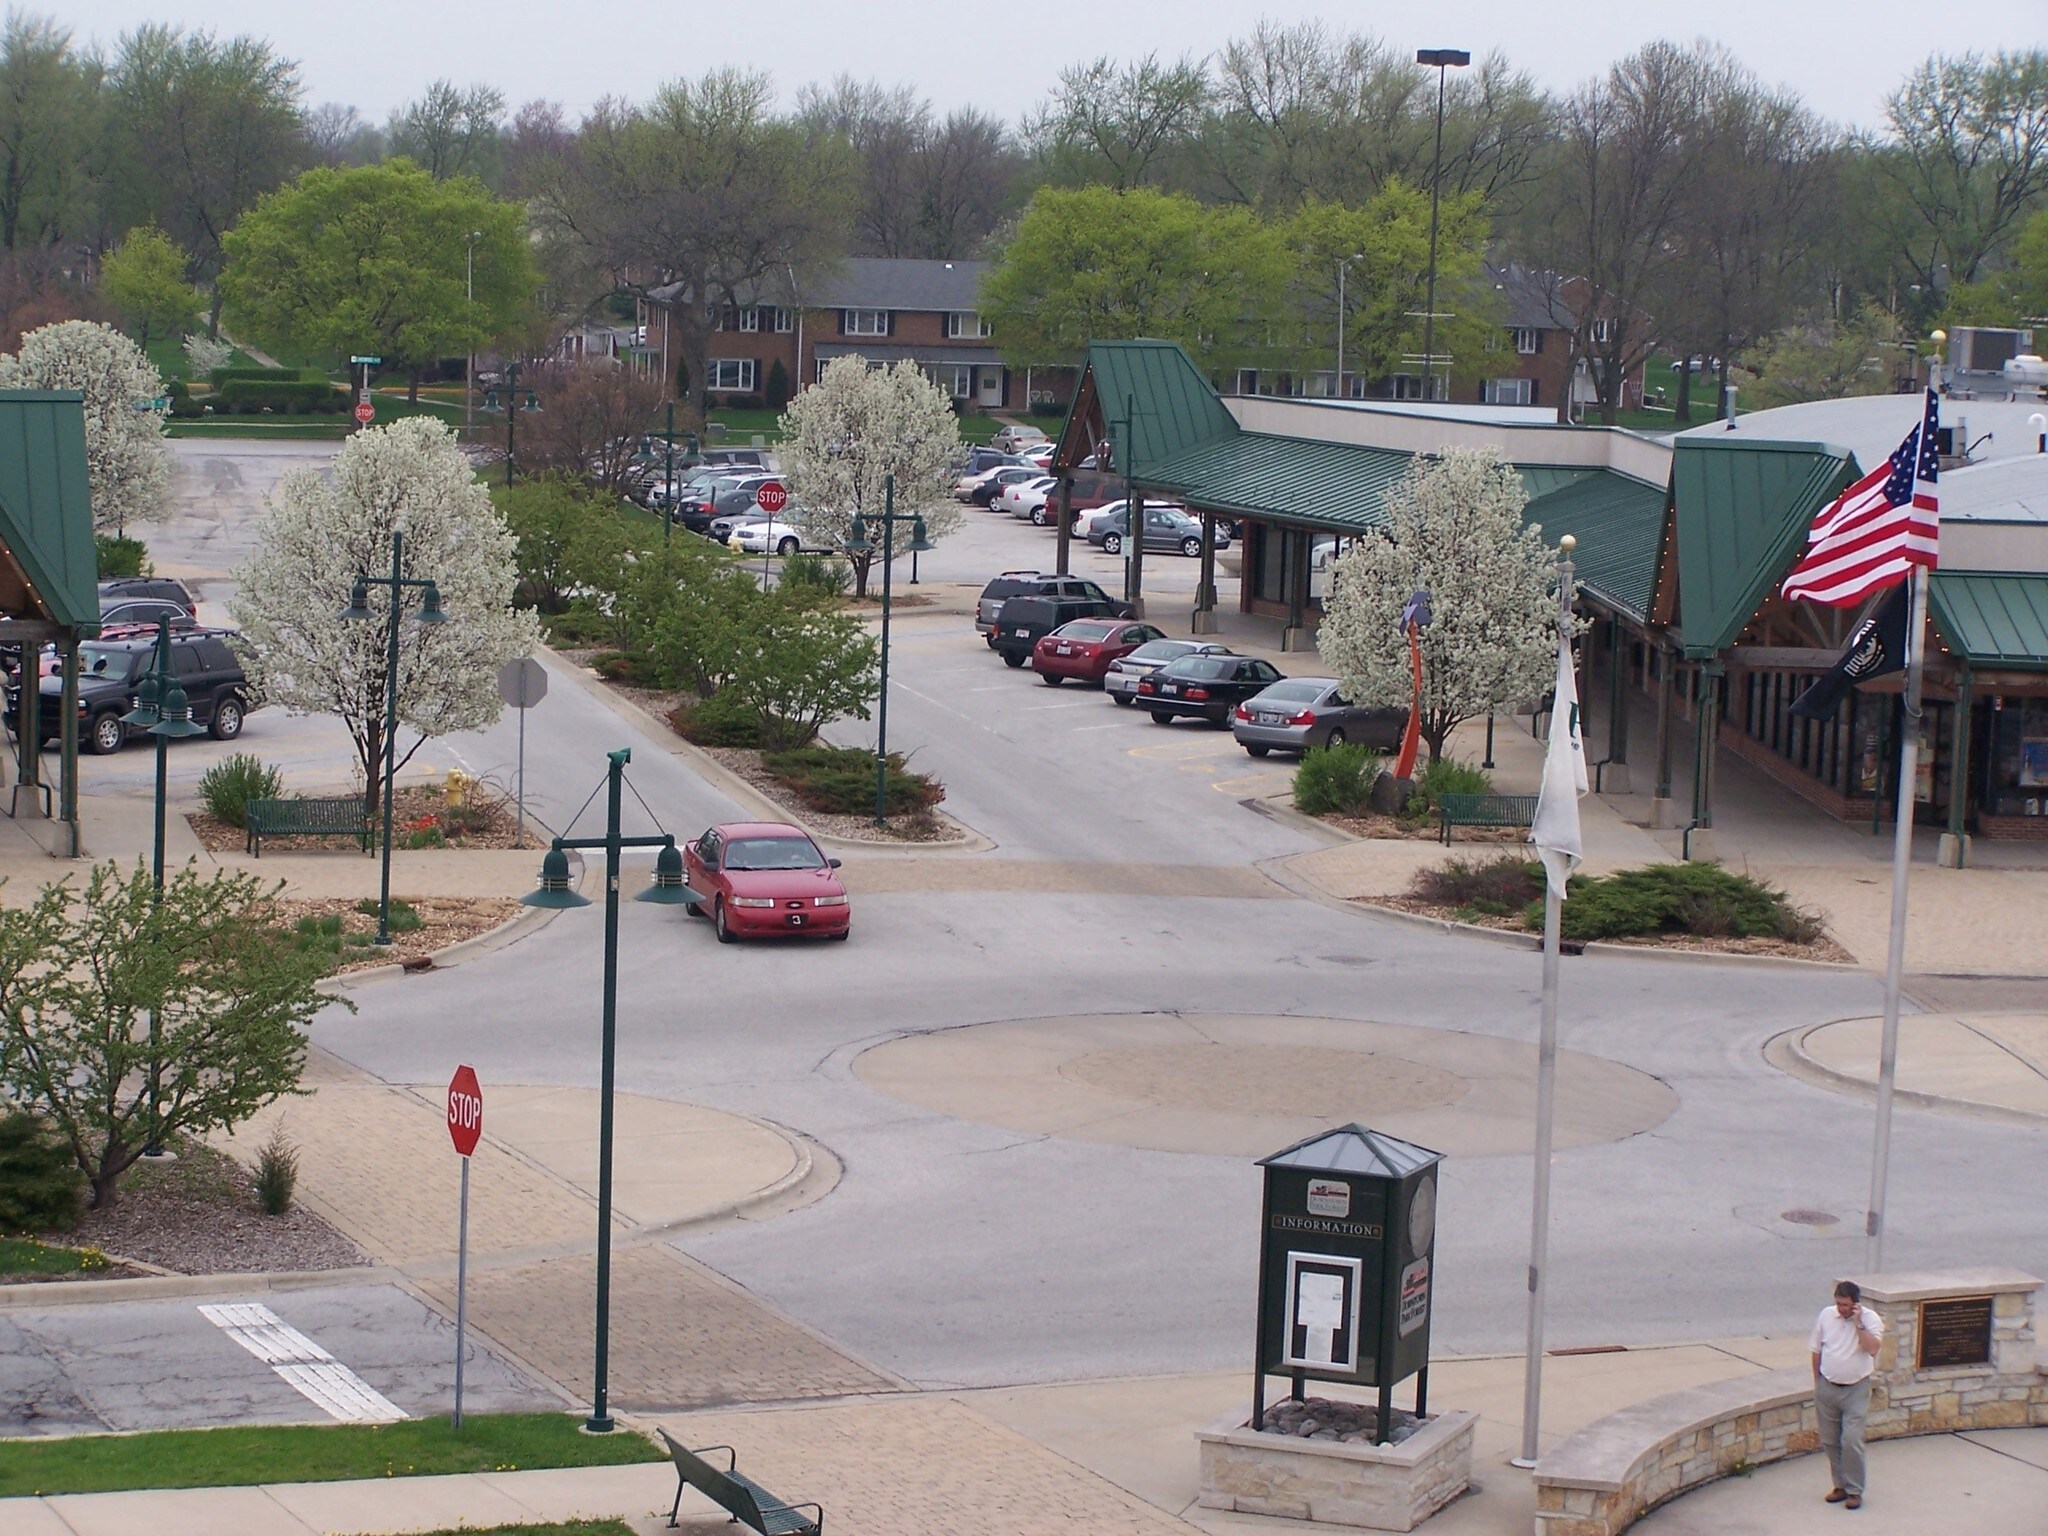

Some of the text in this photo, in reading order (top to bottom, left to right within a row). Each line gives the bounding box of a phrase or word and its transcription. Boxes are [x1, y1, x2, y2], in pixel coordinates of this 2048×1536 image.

[357, 408, 373, 417] STOP
[759, 491, 785, 503] STOP
[449, 1090, 481, 1130] STOP
[1282, 1217, 1373, 1236] INFORMATION
